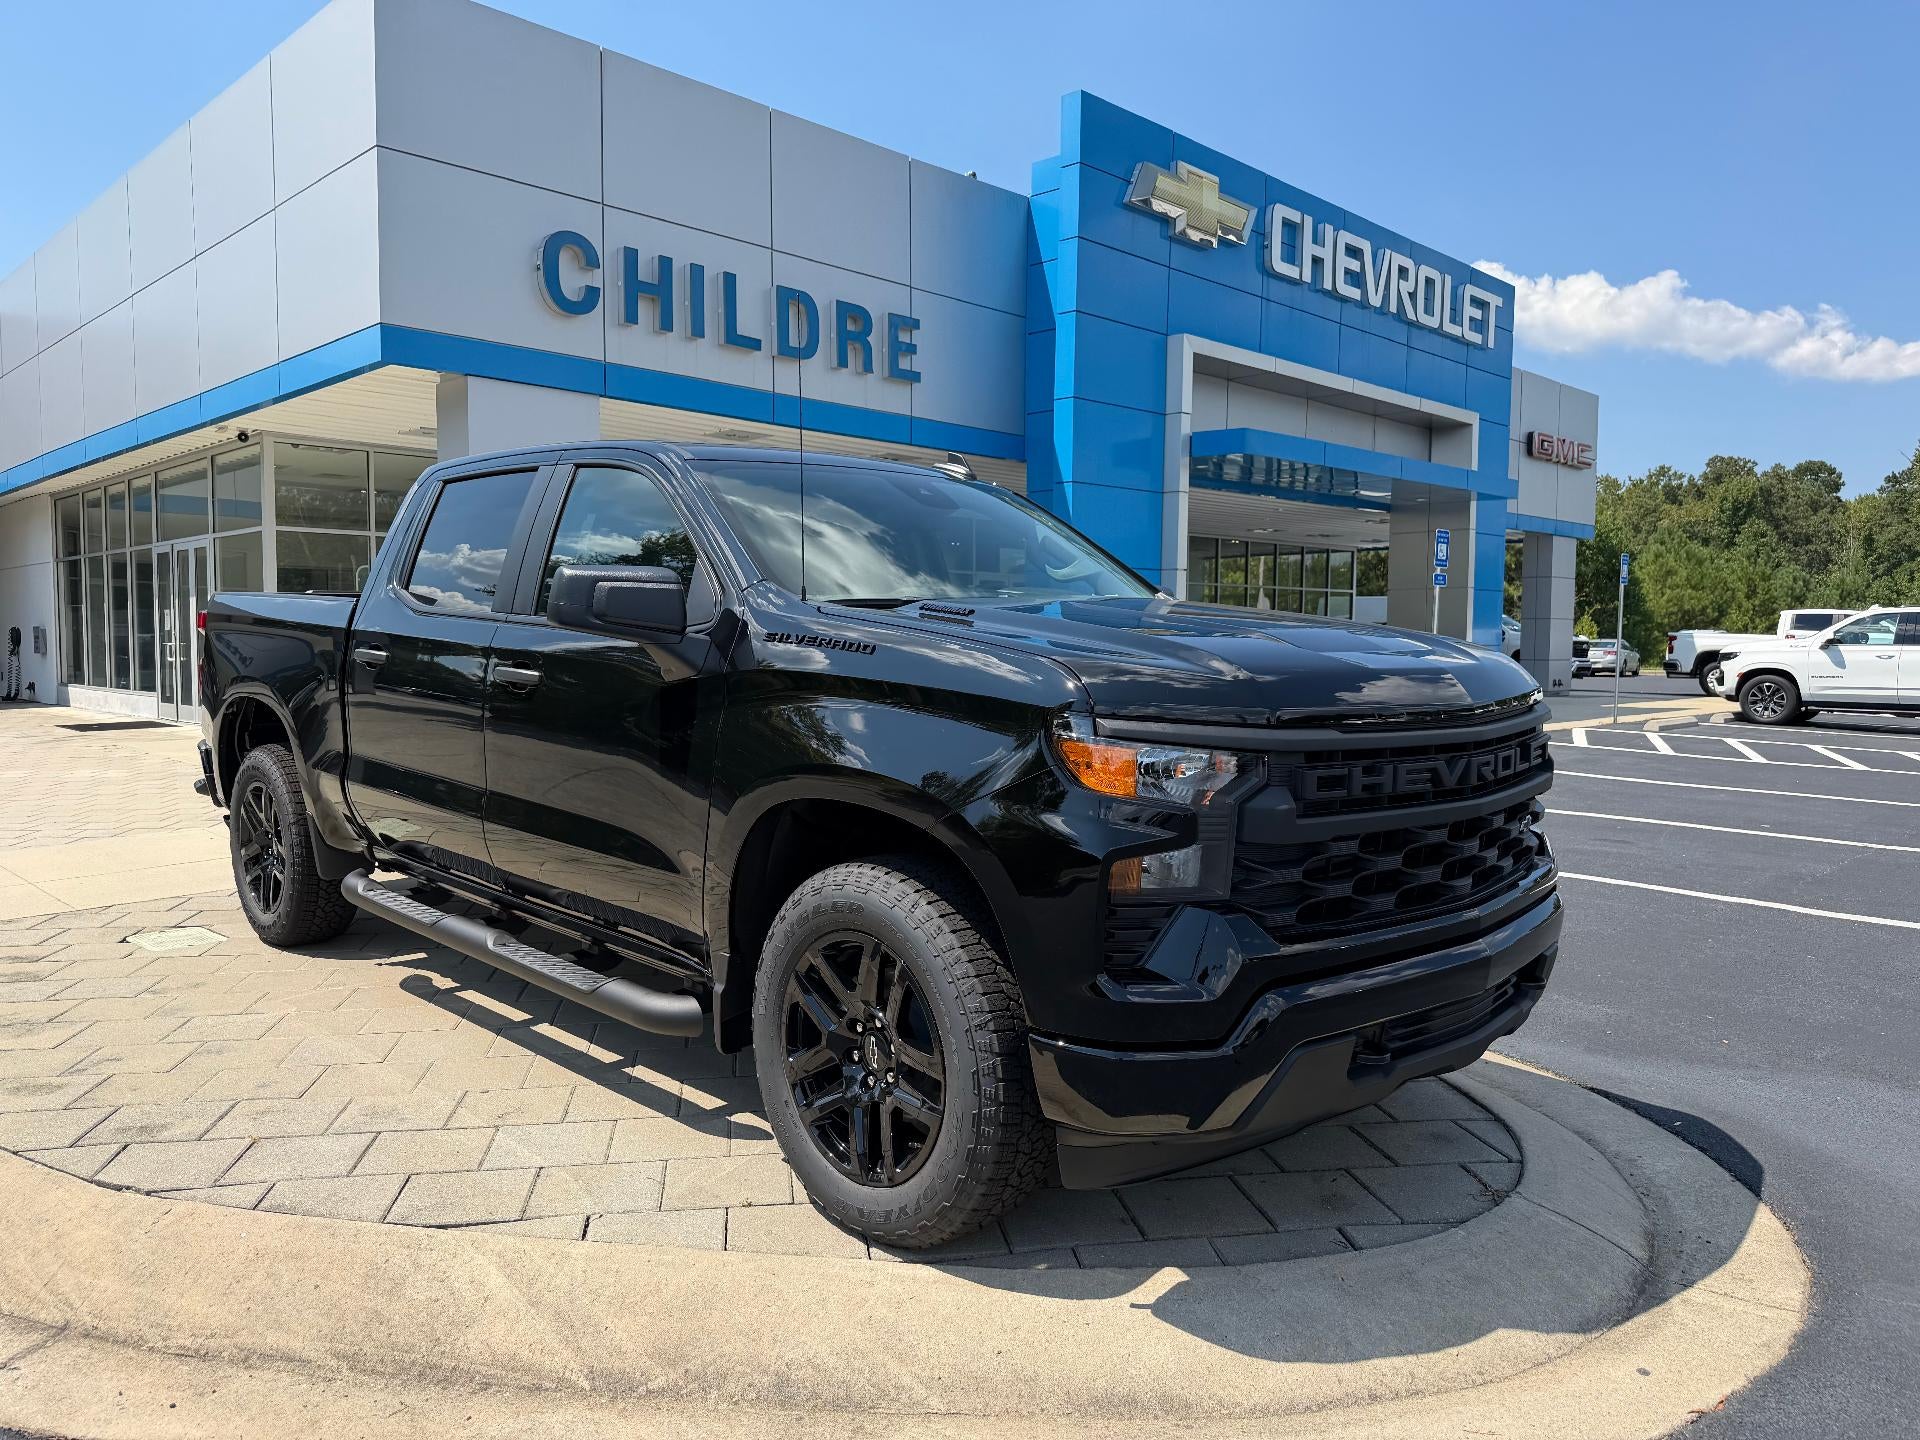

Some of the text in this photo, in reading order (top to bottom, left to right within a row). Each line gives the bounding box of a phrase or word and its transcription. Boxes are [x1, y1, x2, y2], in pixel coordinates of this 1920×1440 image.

[537, 230, 921, 383] CHILDRE
[1265, 202, 1504, 349] CHEVROLET
[1528, 431, 1595, 469] GMC
[762, 631, 877, 656] SILVERADO
